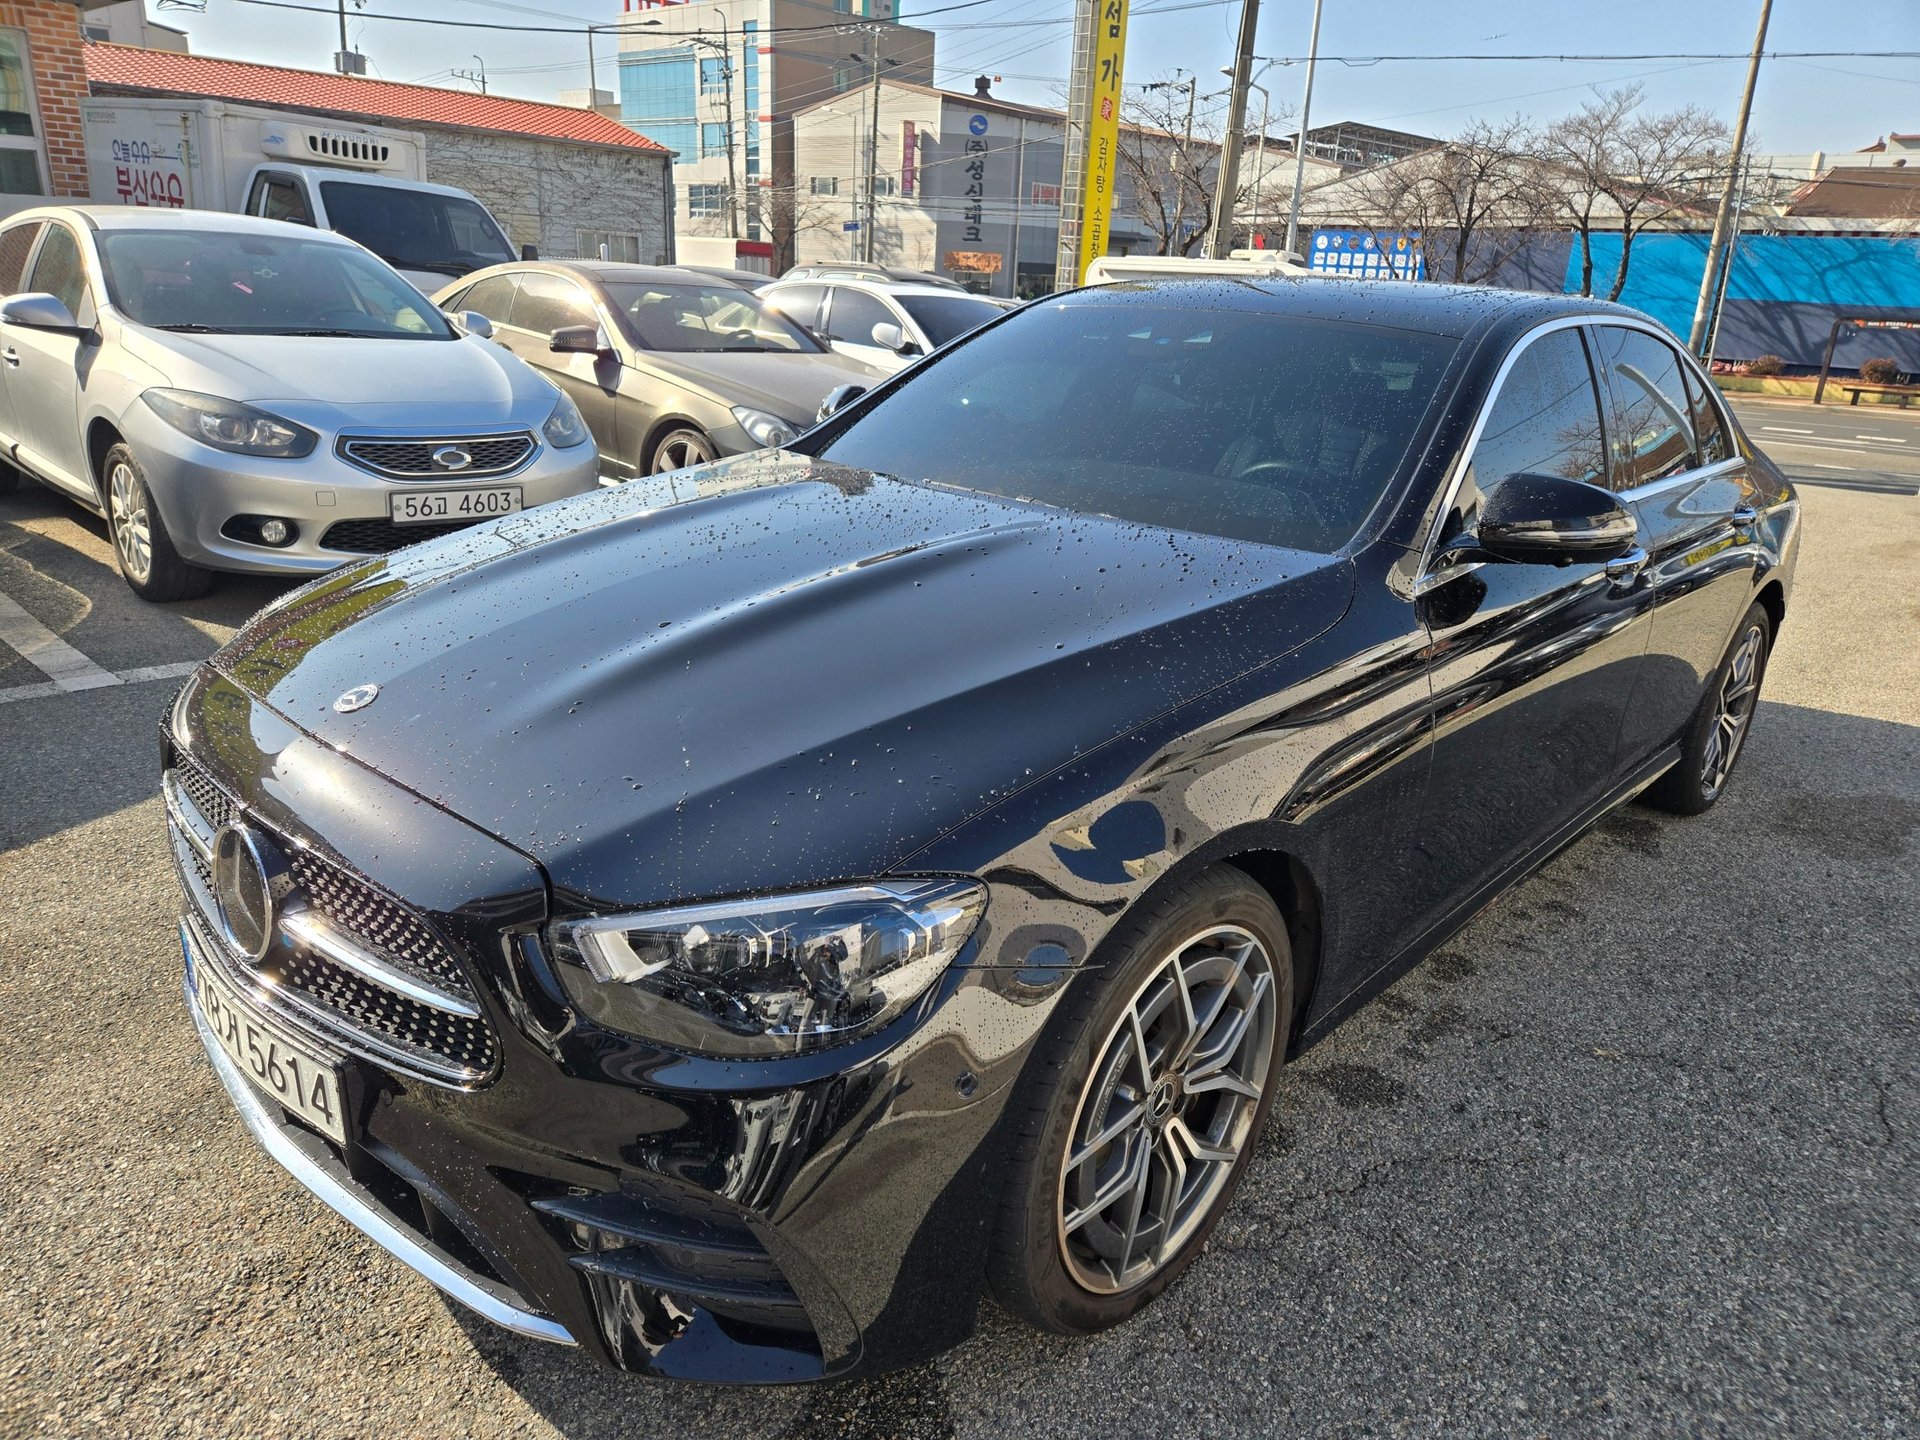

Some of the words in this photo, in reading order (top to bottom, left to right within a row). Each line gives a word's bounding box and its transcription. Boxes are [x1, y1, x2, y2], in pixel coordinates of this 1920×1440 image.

[334, 133, 379, 145] HYUNDAI
[406, 496, 448, 518] 56고
[459, 492, 511, 514] 4603
[247, 1024, 333, 1125] 5614
